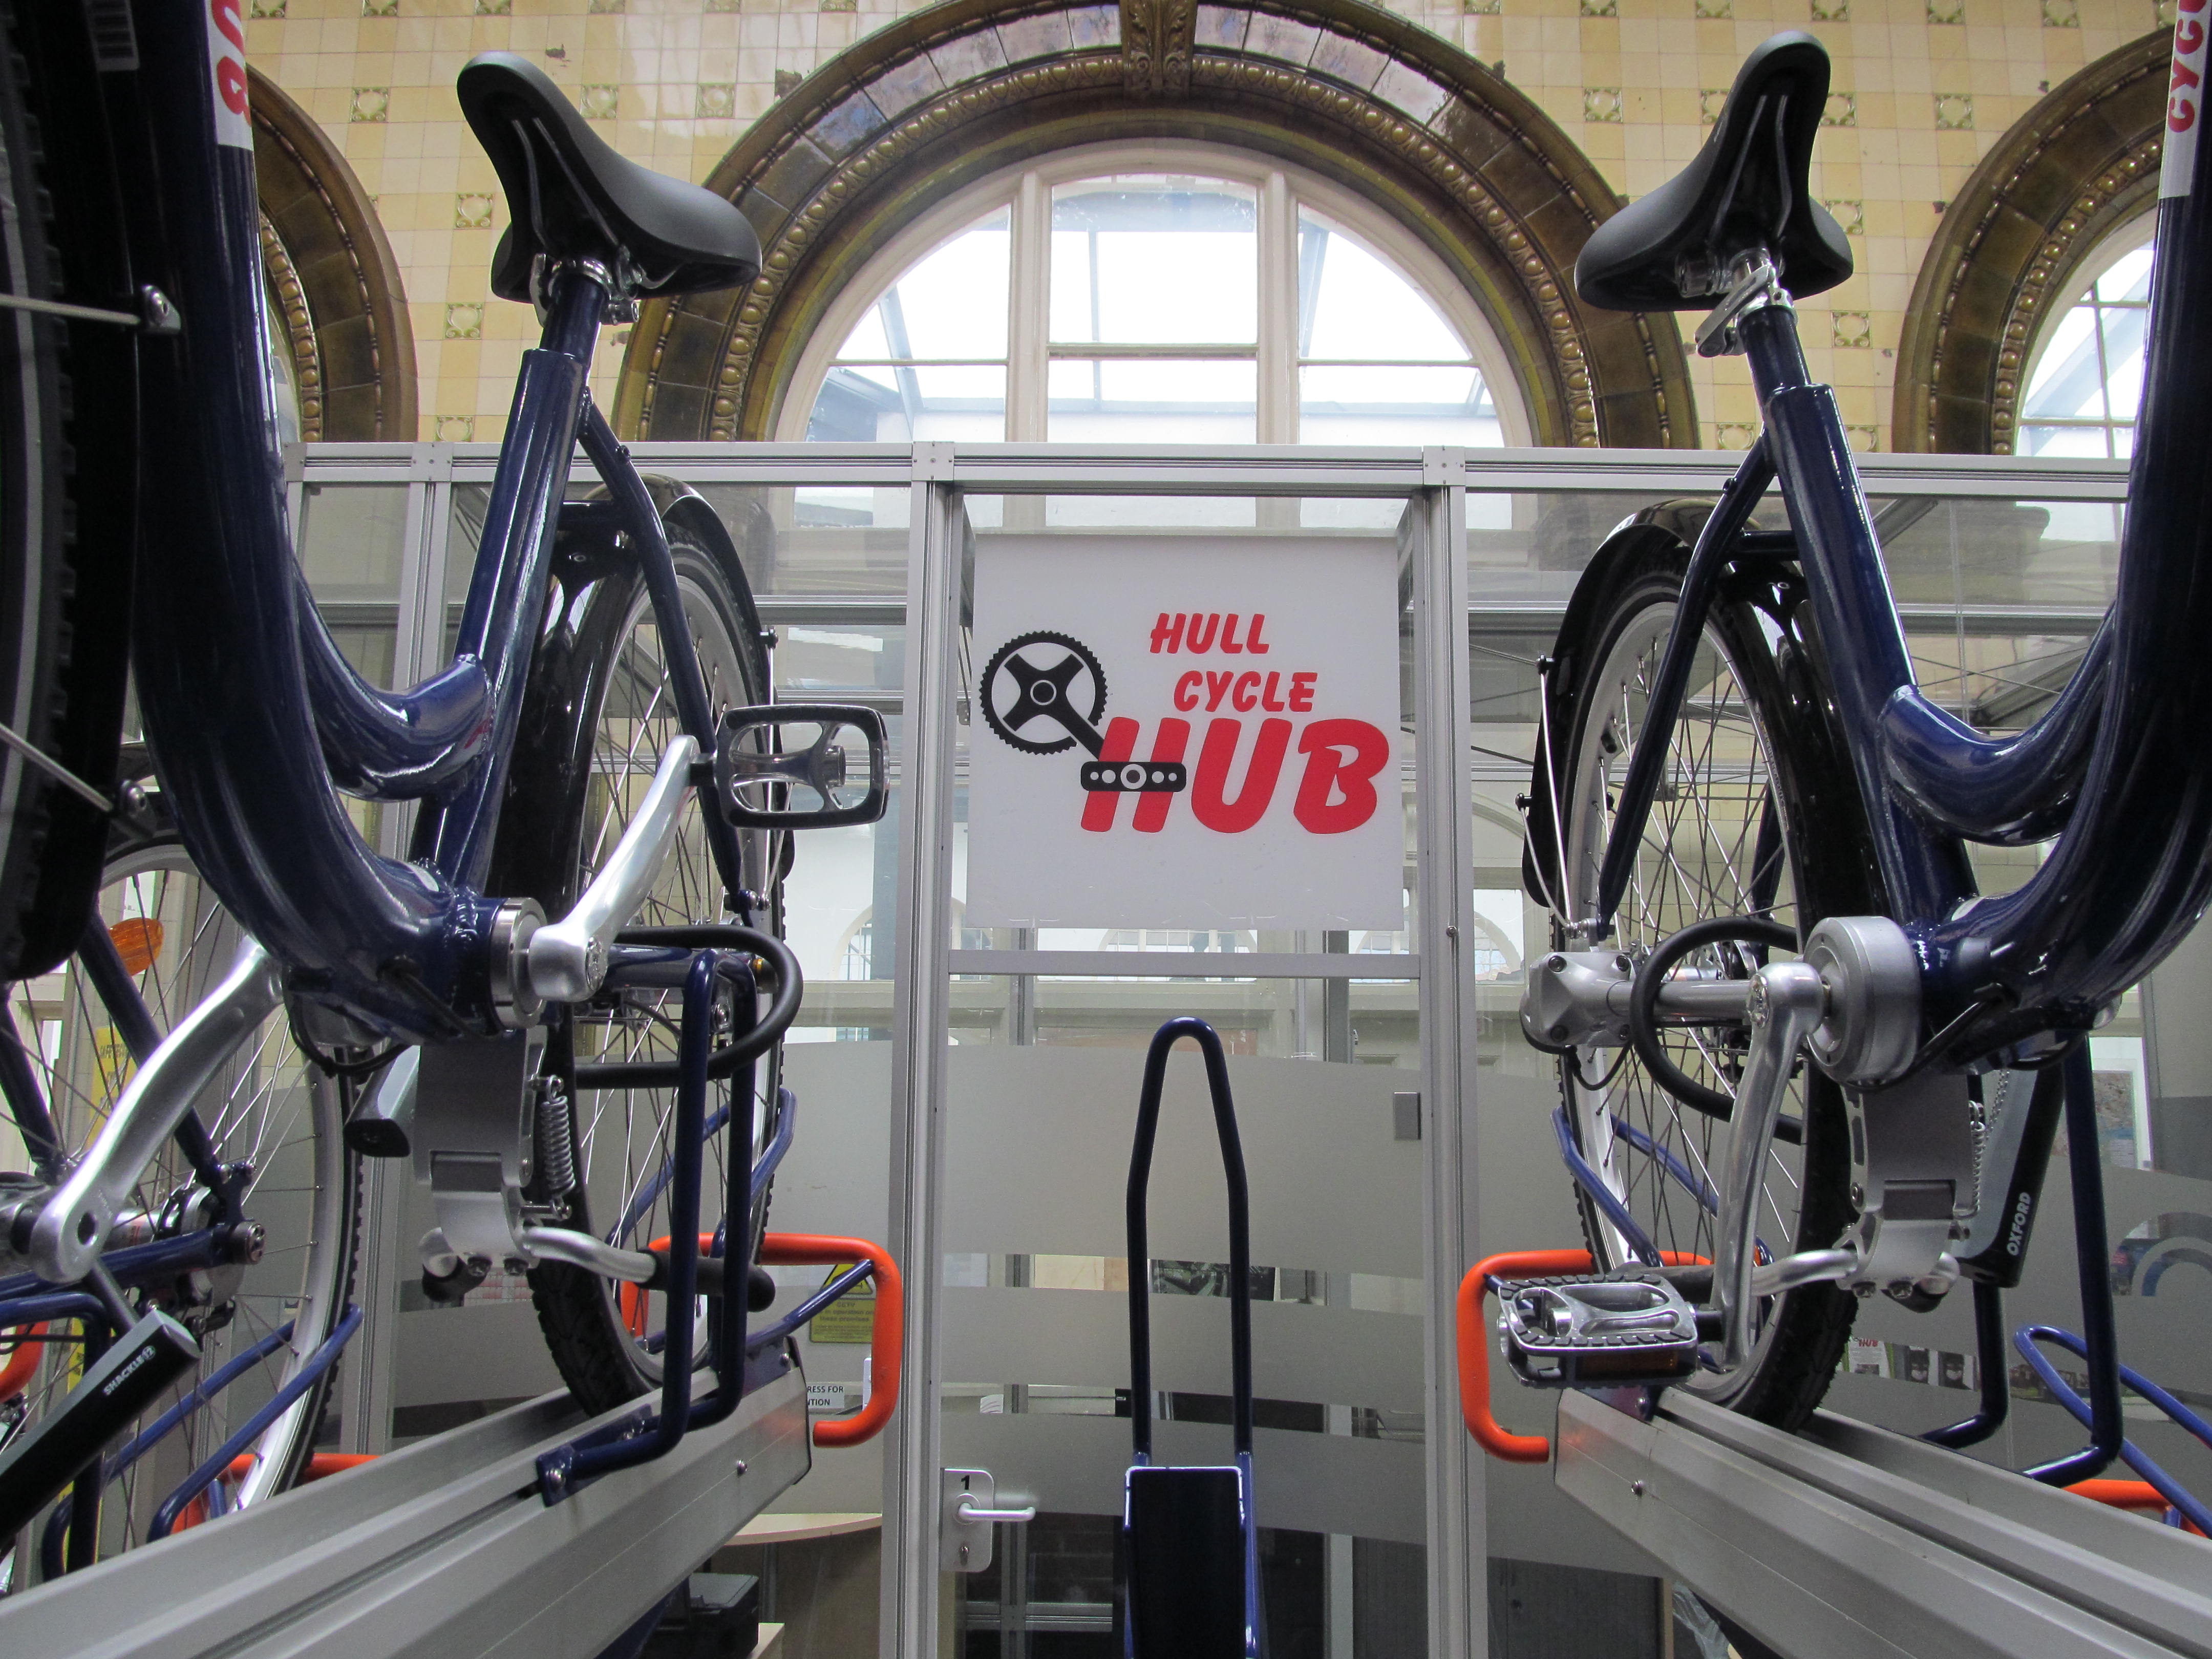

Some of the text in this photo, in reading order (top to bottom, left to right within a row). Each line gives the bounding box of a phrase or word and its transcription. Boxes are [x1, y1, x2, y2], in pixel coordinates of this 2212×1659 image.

[1150, 613, 1270, 655] HULL
[1173, 670, 1318, 712] CYCLE
[1080, 716, 1390, 834] HUB
[2006, 1192, 2031, 1256] OXFORD
[1858, 1339, 1878, 1347] HUB
[961, 1475, 970, 1490] 1
